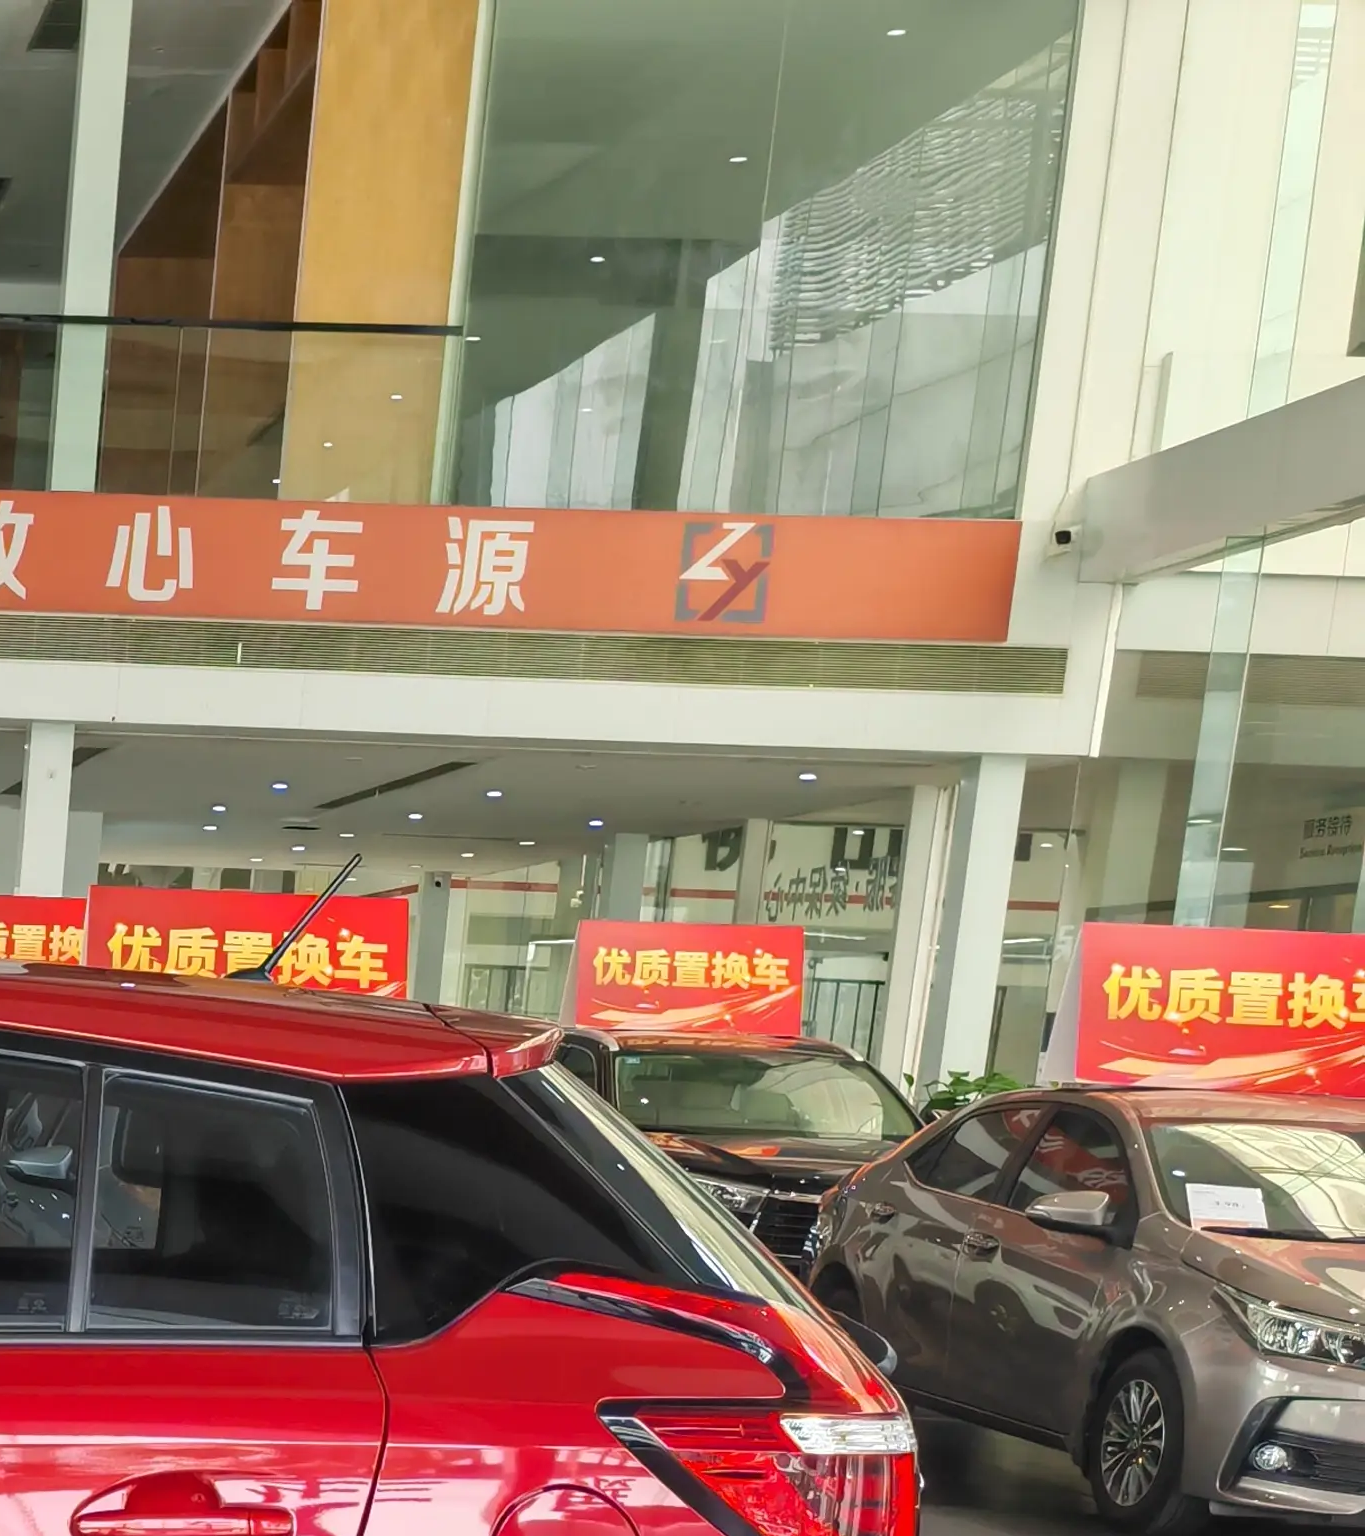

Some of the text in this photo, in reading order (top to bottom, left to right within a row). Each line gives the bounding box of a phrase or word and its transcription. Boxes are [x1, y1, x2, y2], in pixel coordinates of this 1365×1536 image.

[107, 923, 388, 989] 优质置换车
[592, 946, 790, 991] 优质置换车
[1103, 963, 1365, 1030] 优质置换
